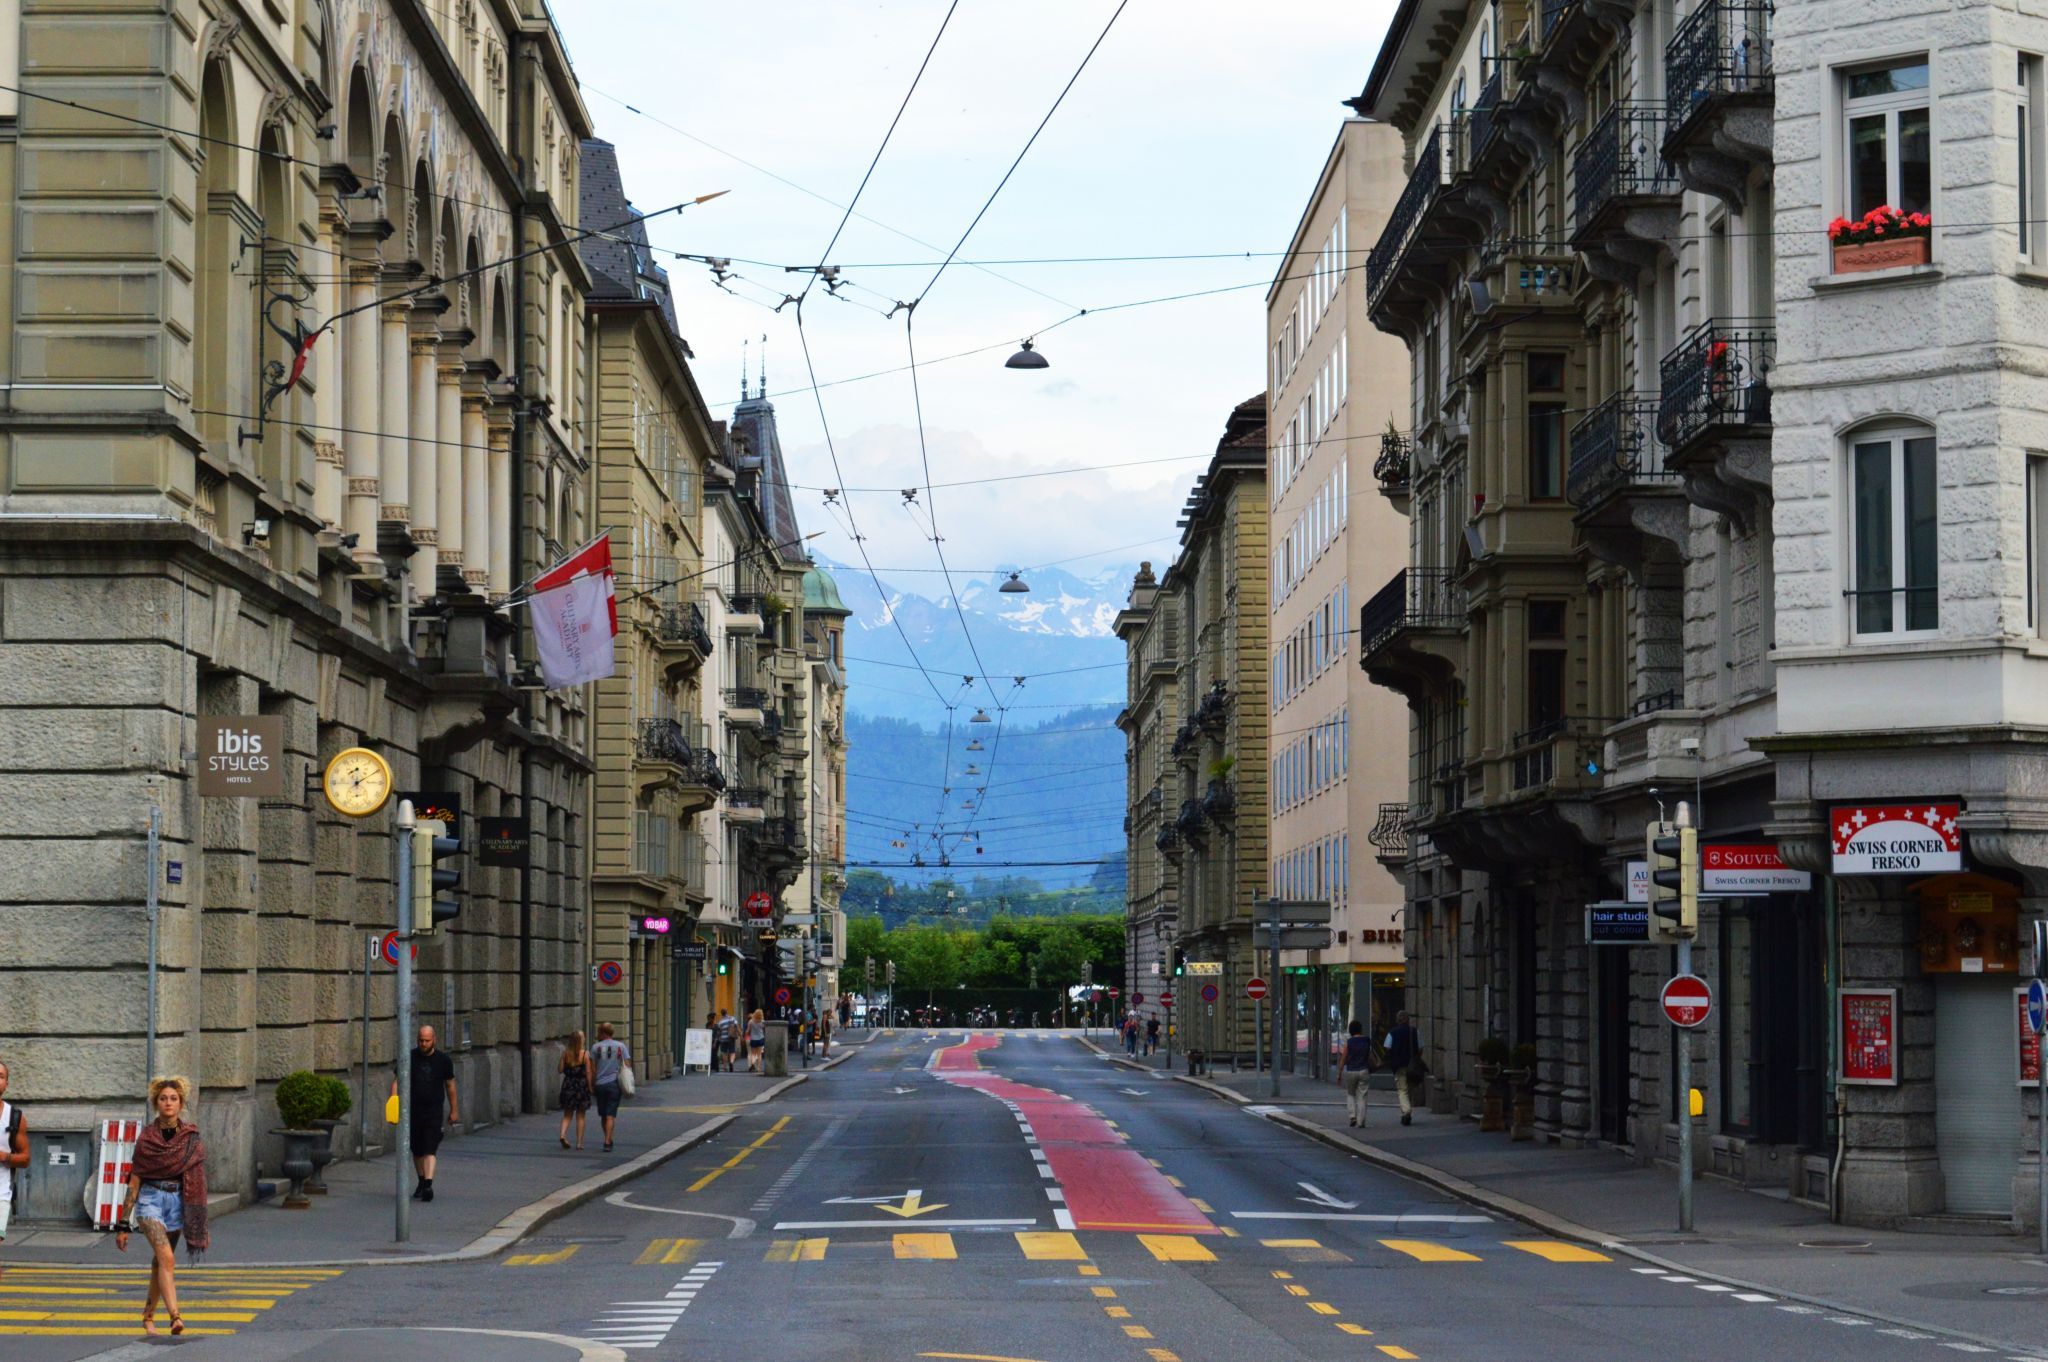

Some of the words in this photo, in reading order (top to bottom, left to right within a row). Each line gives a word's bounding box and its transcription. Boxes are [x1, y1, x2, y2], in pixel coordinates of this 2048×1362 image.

[217, 728, 262, 754] ibis
[1848, 841, 1887, 855] SWISS
[1890, 840, 1944, 853] CORNER
[1724, 852, 1783, 865] SOUVEN
[1872, 855, 1921, 869] FRESCO
[1634, 871, 1648, 880] AU
[1715, 876, 1738, 884] SWISS
[1740, 876, 1770, 884] CORNER
[1773, 876, 1801, 884] FRESCO
[1593, 911, 1615, 921] hair
[1363, 929, 1404, 944] BIK
